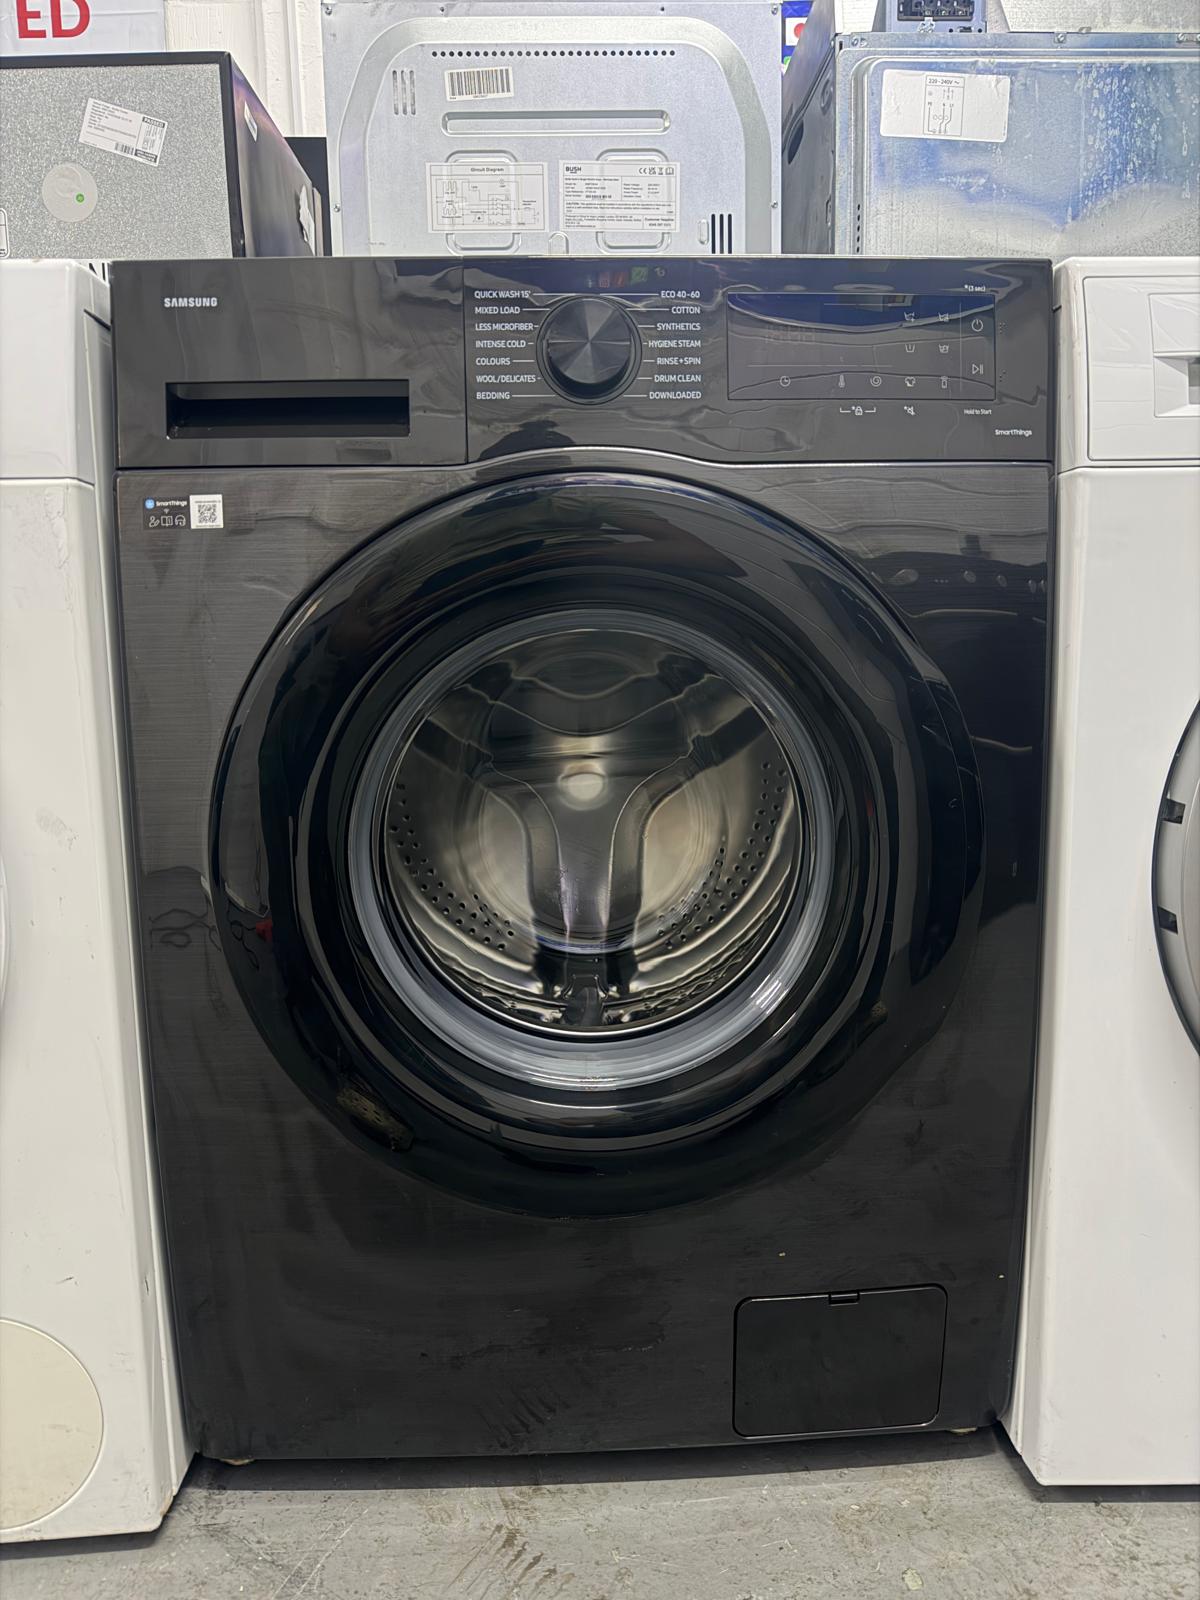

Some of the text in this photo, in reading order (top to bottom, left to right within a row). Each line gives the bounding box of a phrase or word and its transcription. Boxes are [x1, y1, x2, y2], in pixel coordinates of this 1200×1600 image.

[16, 0, 90, 38] ED
[474, 290, 498, 299] QUICK
[498, 290, 520, 298] WASH
[660, 290, 676, 298] ECO
[163, 297, 218, 308] SAMSUNG
[474, 306, 521, 314] MIXED LOAD
[671, 306, 701, 314] COTTON
[475, 323, 534, 331] LESS MICROFIBER
[656, 322, 701, 331] SYNTHETICS
[475, 340, 526, 348] INTENSE COLD
[648, 340, 701, 348] HYGIENE STEAM
[475, 357, 511, 366] COLOURS
[654, 374, 701, 382] DRUM CLEAN
[476, 391, 510, 400] BEDDING
[649, 391, 702, 399] DOWNLOADED
[994, 429, 1033, 437] SmartThings
